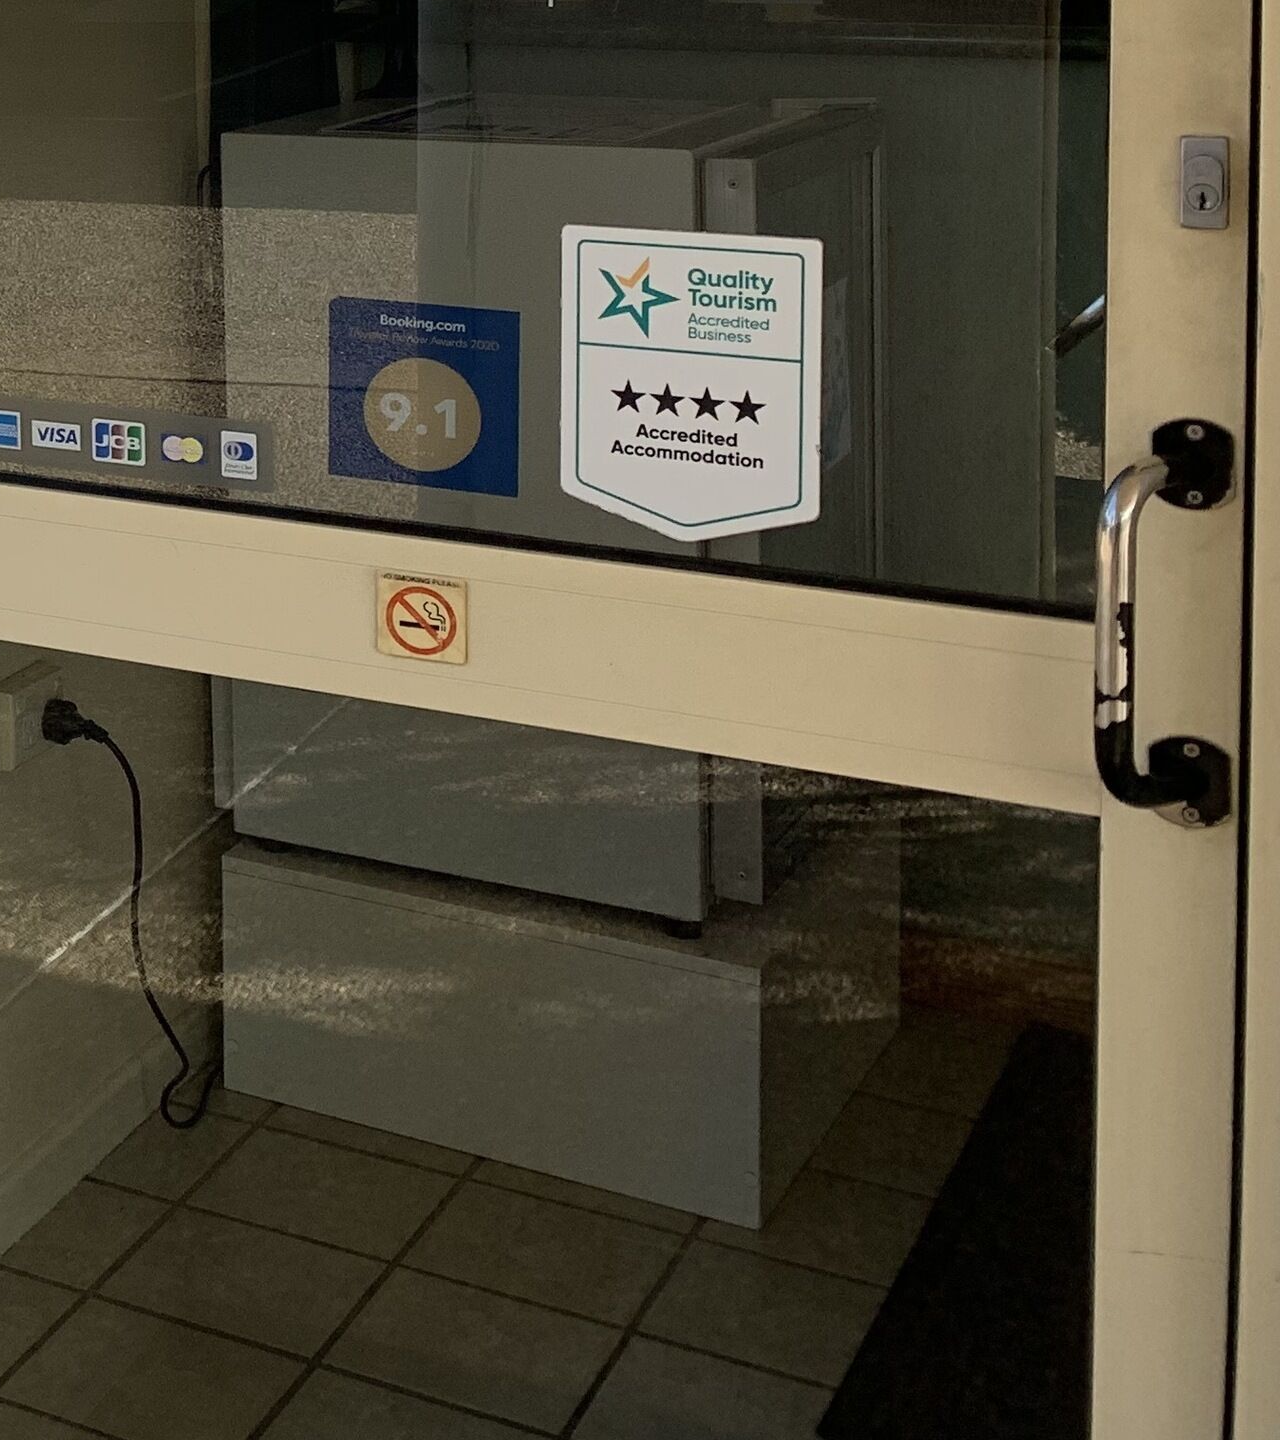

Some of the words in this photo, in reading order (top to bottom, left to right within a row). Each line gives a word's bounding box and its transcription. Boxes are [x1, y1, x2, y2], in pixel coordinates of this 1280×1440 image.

[687, 268, 774, 295] Quality
[687, 288, 777, 313] Tourism
[379, 313, 467, 333] Booking.com
[687, 313, 770, 331] Accredited
[429, 335, 469, 348] Awards
[470, 338, 501, 352] 2020
[687, 327, 752, 344] Business
[379, 392, 457, 440] 9.1
[37, 426, 78, 446] VISA
[95, 433, 141, 452] JCB
[635, 424, 738, 448] Accredited
[610, 440, 764, 469] Accommodation
